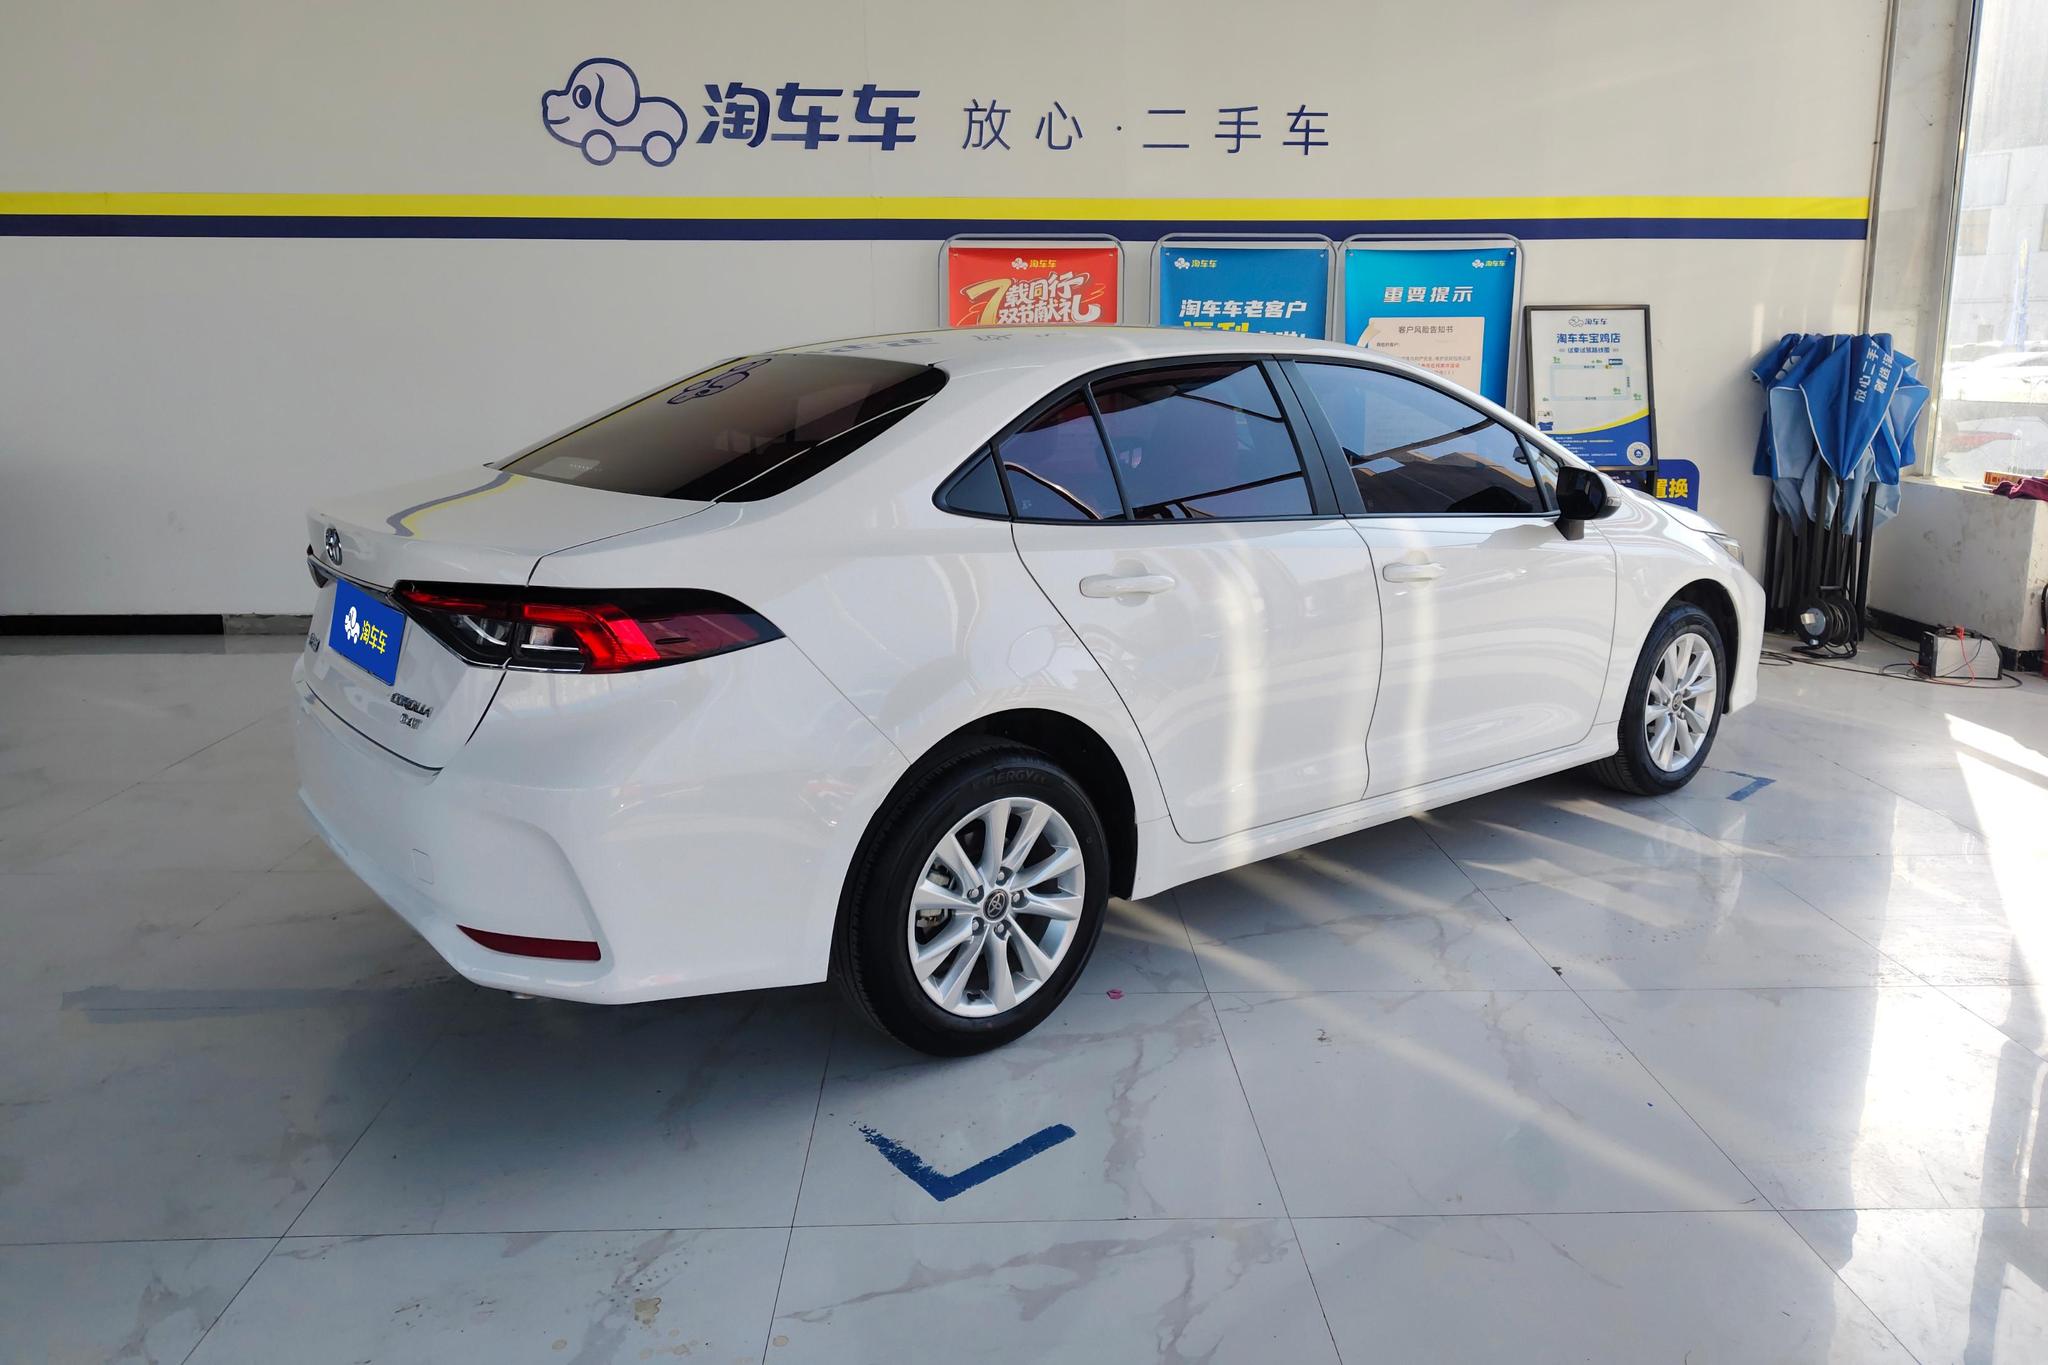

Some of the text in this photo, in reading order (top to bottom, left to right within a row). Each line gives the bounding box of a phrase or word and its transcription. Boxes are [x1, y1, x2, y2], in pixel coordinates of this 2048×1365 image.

[697, 82, 921, 151] 淘车车
[1029, 259, 1057, 268] 淘车车
[1191, 259, 1217, 268] 淘车车
[1383, 286, 1474, 303] 重要提示
[999, 295, 1101, 325] 双节献礼
[1179, 299, 1308, 319] 淘车车老客户
[1398, 325, 1454, 334] 客户风险告知书
[1556, 333, 1621, 344] 淘车车宝鸡店
[360, 620, 388, 654] 淘车车
